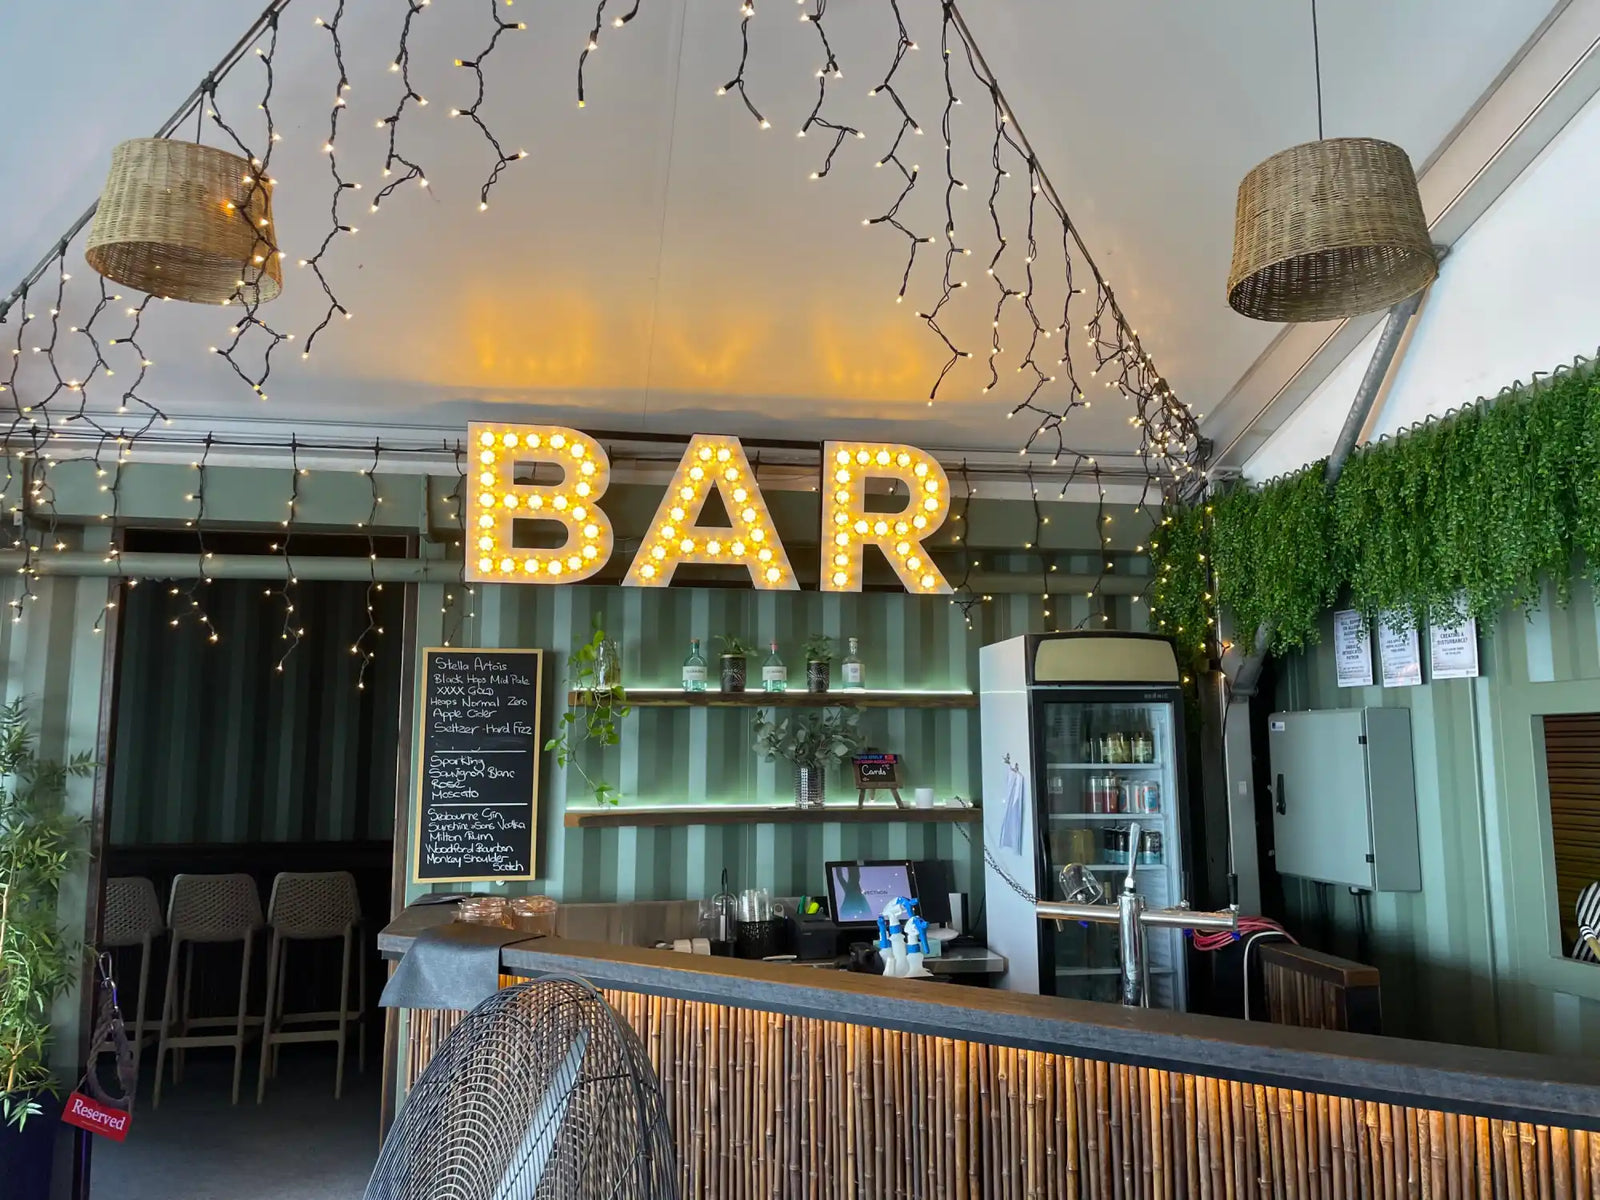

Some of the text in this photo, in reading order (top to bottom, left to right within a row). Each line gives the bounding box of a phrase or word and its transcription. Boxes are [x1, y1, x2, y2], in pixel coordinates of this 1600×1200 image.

[465, 421, 955, 595] BAR
[435, 656, 508, 671] Stella Artois
[433, 673, 530, 687] Black Hops Mid Pale
[436, 686, 466, 695] XXXX
[430, 696, 528, 709] Heaps Normal Zero
[432, 708, 497, 722] Apple Cider
[434, 722, 480, 735] Seltzer
[486, 722, 511, 734] Hard
[513, 721, 533, 735] Fizz
[430, 755, 486, 772] Sparkling
[861, 764, 887, 776] Cards
[428, 766, 516, 782] Sauvignon Blanc
[431, 787, 479, 800] Moscato
[481, 807, 503, 820] Gin
[428, 822, 469, 832] Sunshine
[474, 821, 495, 830] Sons
[497, 819, 526, 830] Vodka
[429, 831, 494, 842] Milton Rum
[425, 841, 514, 853] Woodford Bourbon
[426, 852, 510, 868] Monkey Shoulder
[492, 860, 525, 871] Scotch
[71, 1098, 126, 1131] Reserved
